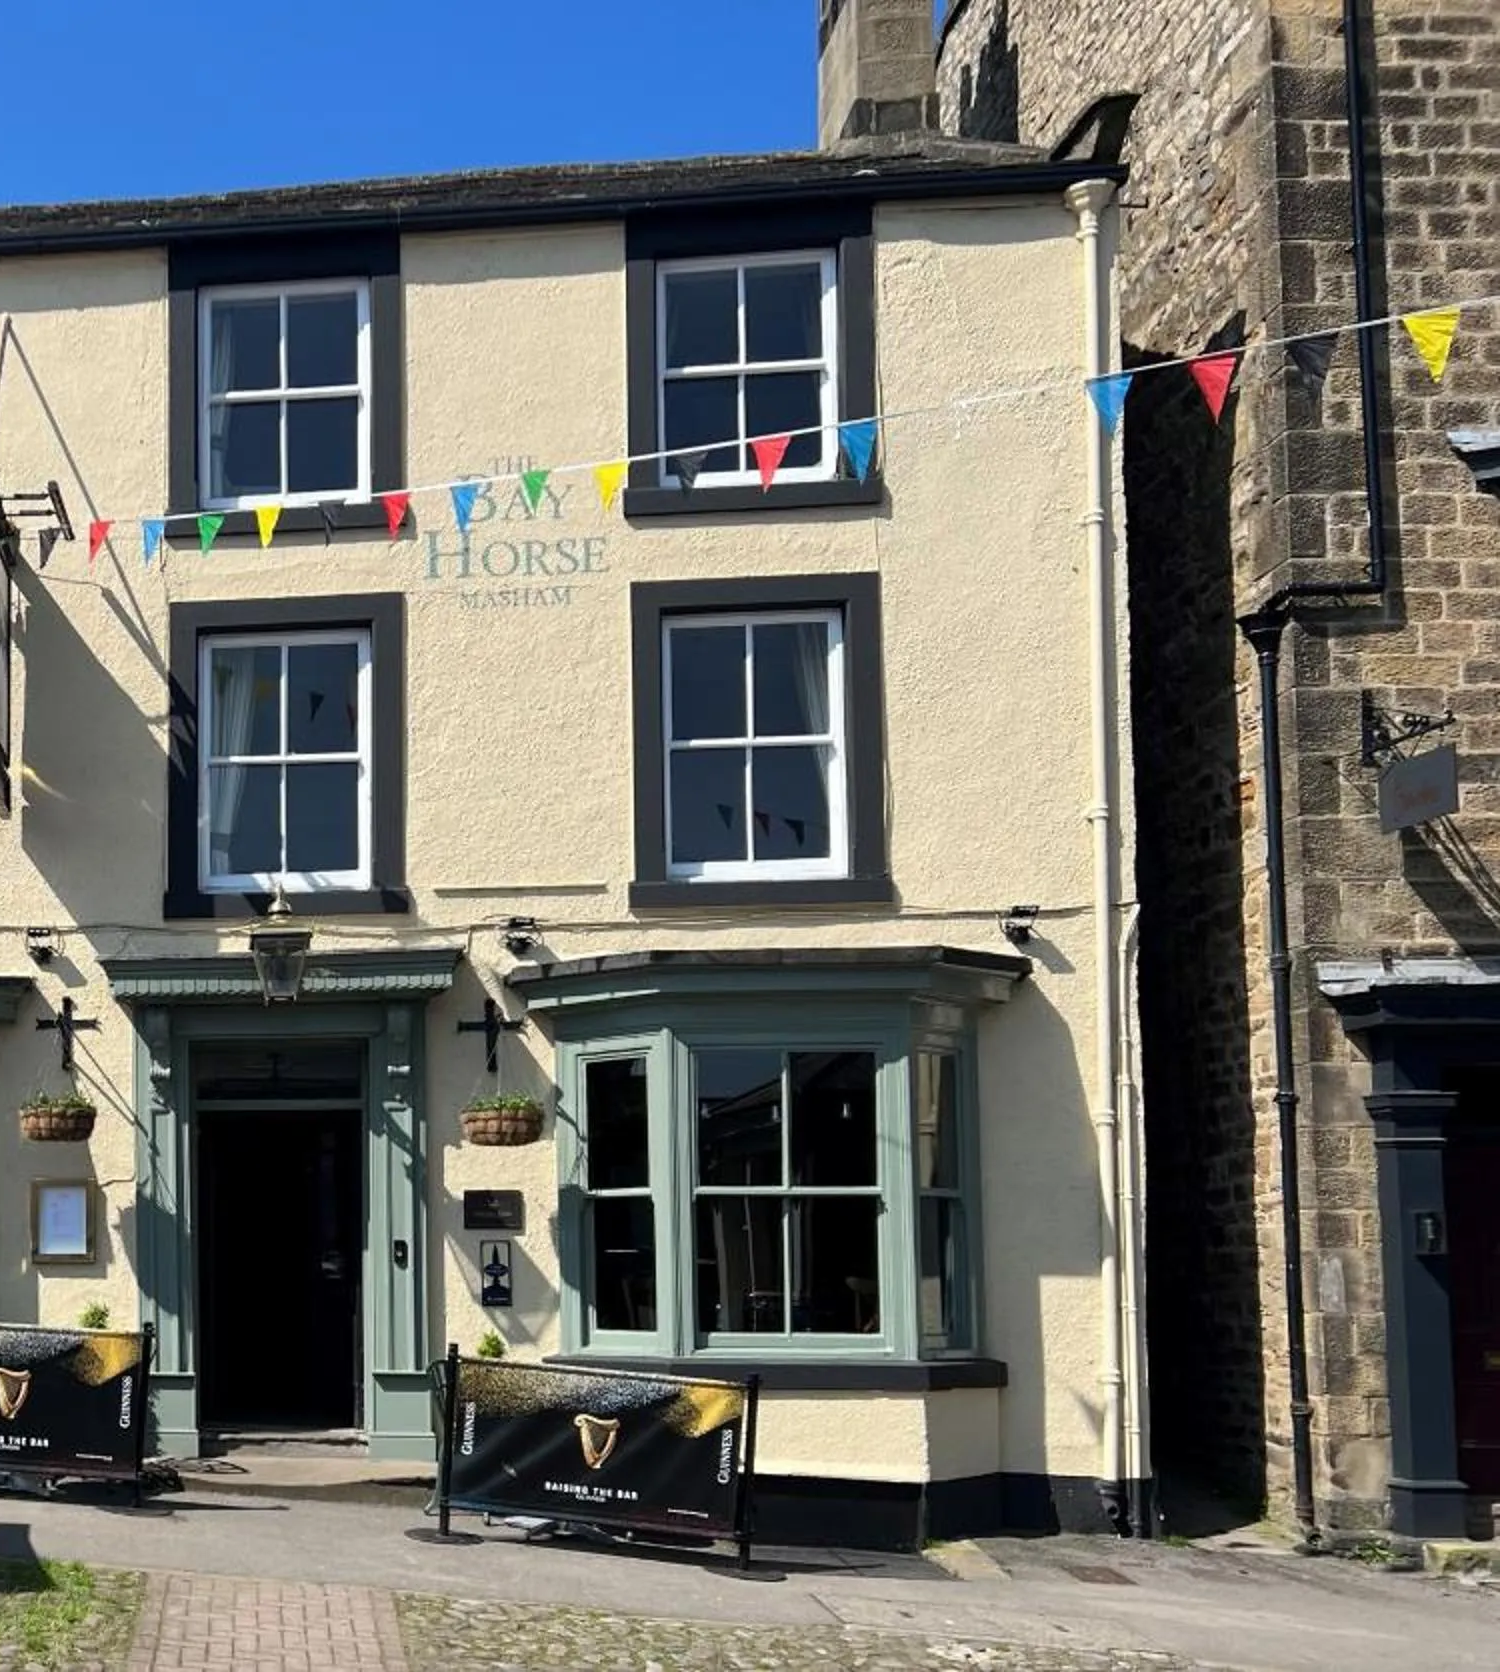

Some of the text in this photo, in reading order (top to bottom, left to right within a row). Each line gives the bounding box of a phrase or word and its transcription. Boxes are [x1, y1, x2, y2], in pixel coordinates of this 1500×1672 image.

[422, 528, 611, 580] HORSE
[461, 586, 572, 609] MASHAM
[119, 1376, 133, 1429] GUINNESS
[460, 1401, 476, 1456] GUINNESS
[9, 1435, 26, 1446] THE
[717, 1429, 734, 1485] GUINNESS
[544, 1481, 589, 1495] RAISING
[592, 1487, 612, 1498] THE
[617, 1489, 638, 1501] BAR
